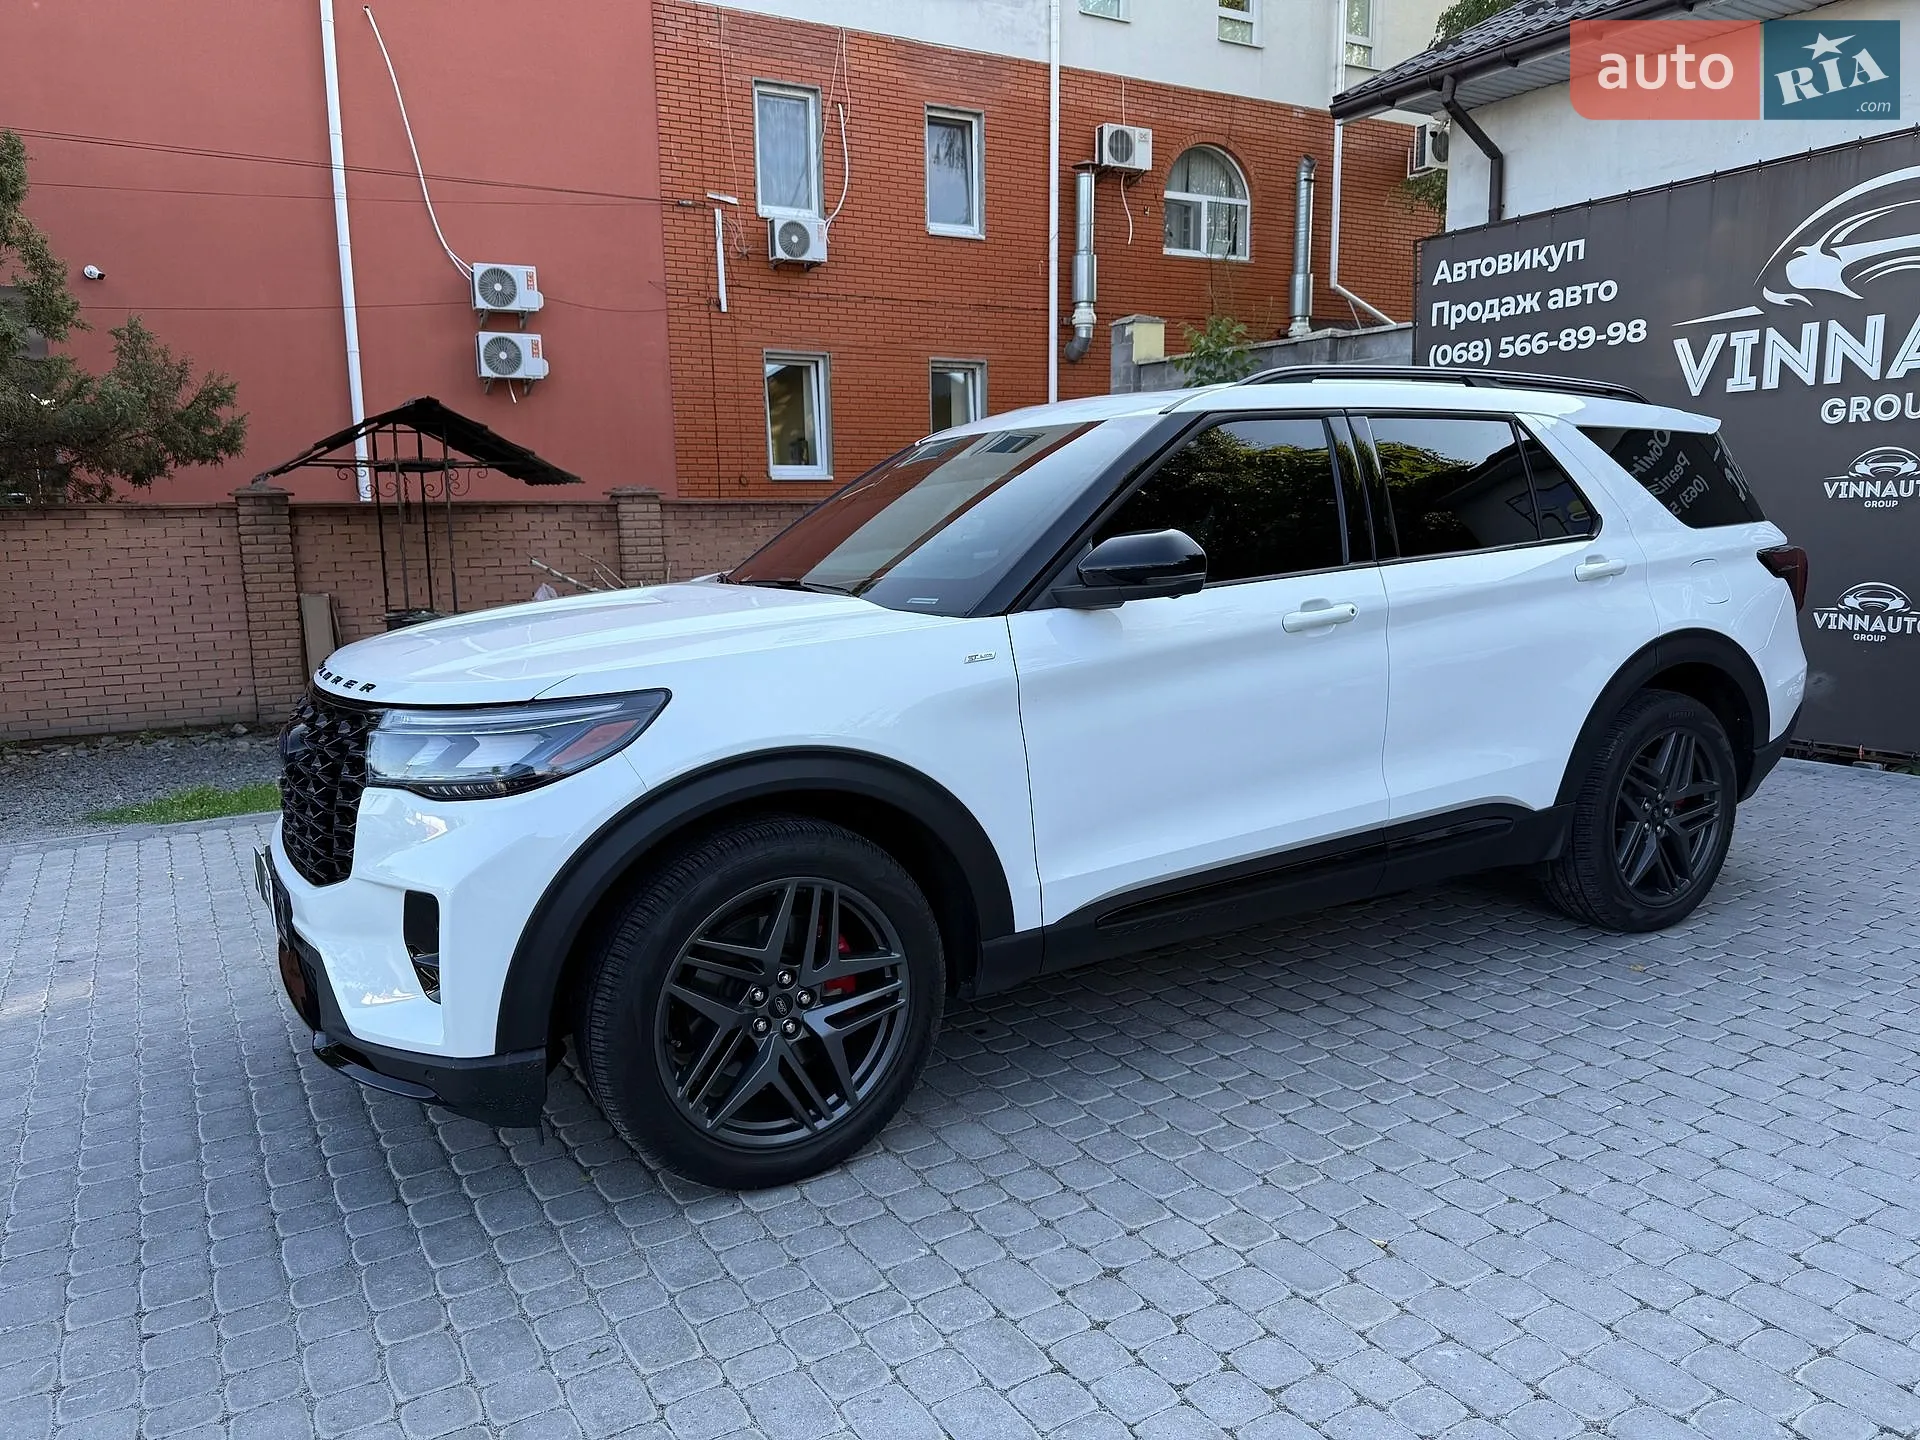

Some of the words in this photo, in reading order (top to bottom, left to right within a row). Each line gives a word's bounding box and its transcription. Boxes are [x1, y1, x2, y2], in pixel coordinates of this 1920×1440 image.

[1432, 238, 1585, 286] Автовикуп
[1431, 291, 1542, 330] Продаж
[1547, 279, 1618, 310] авто
[1429, 338, 1492, 367] (068)
[1498, 318, 1647, 358] 566-89-98
[1864, 500, 1899, 508] GROUP
[1813, 612, 1920, 634] VINNAUT
[1853, 633, 1887, 642] GROUP
